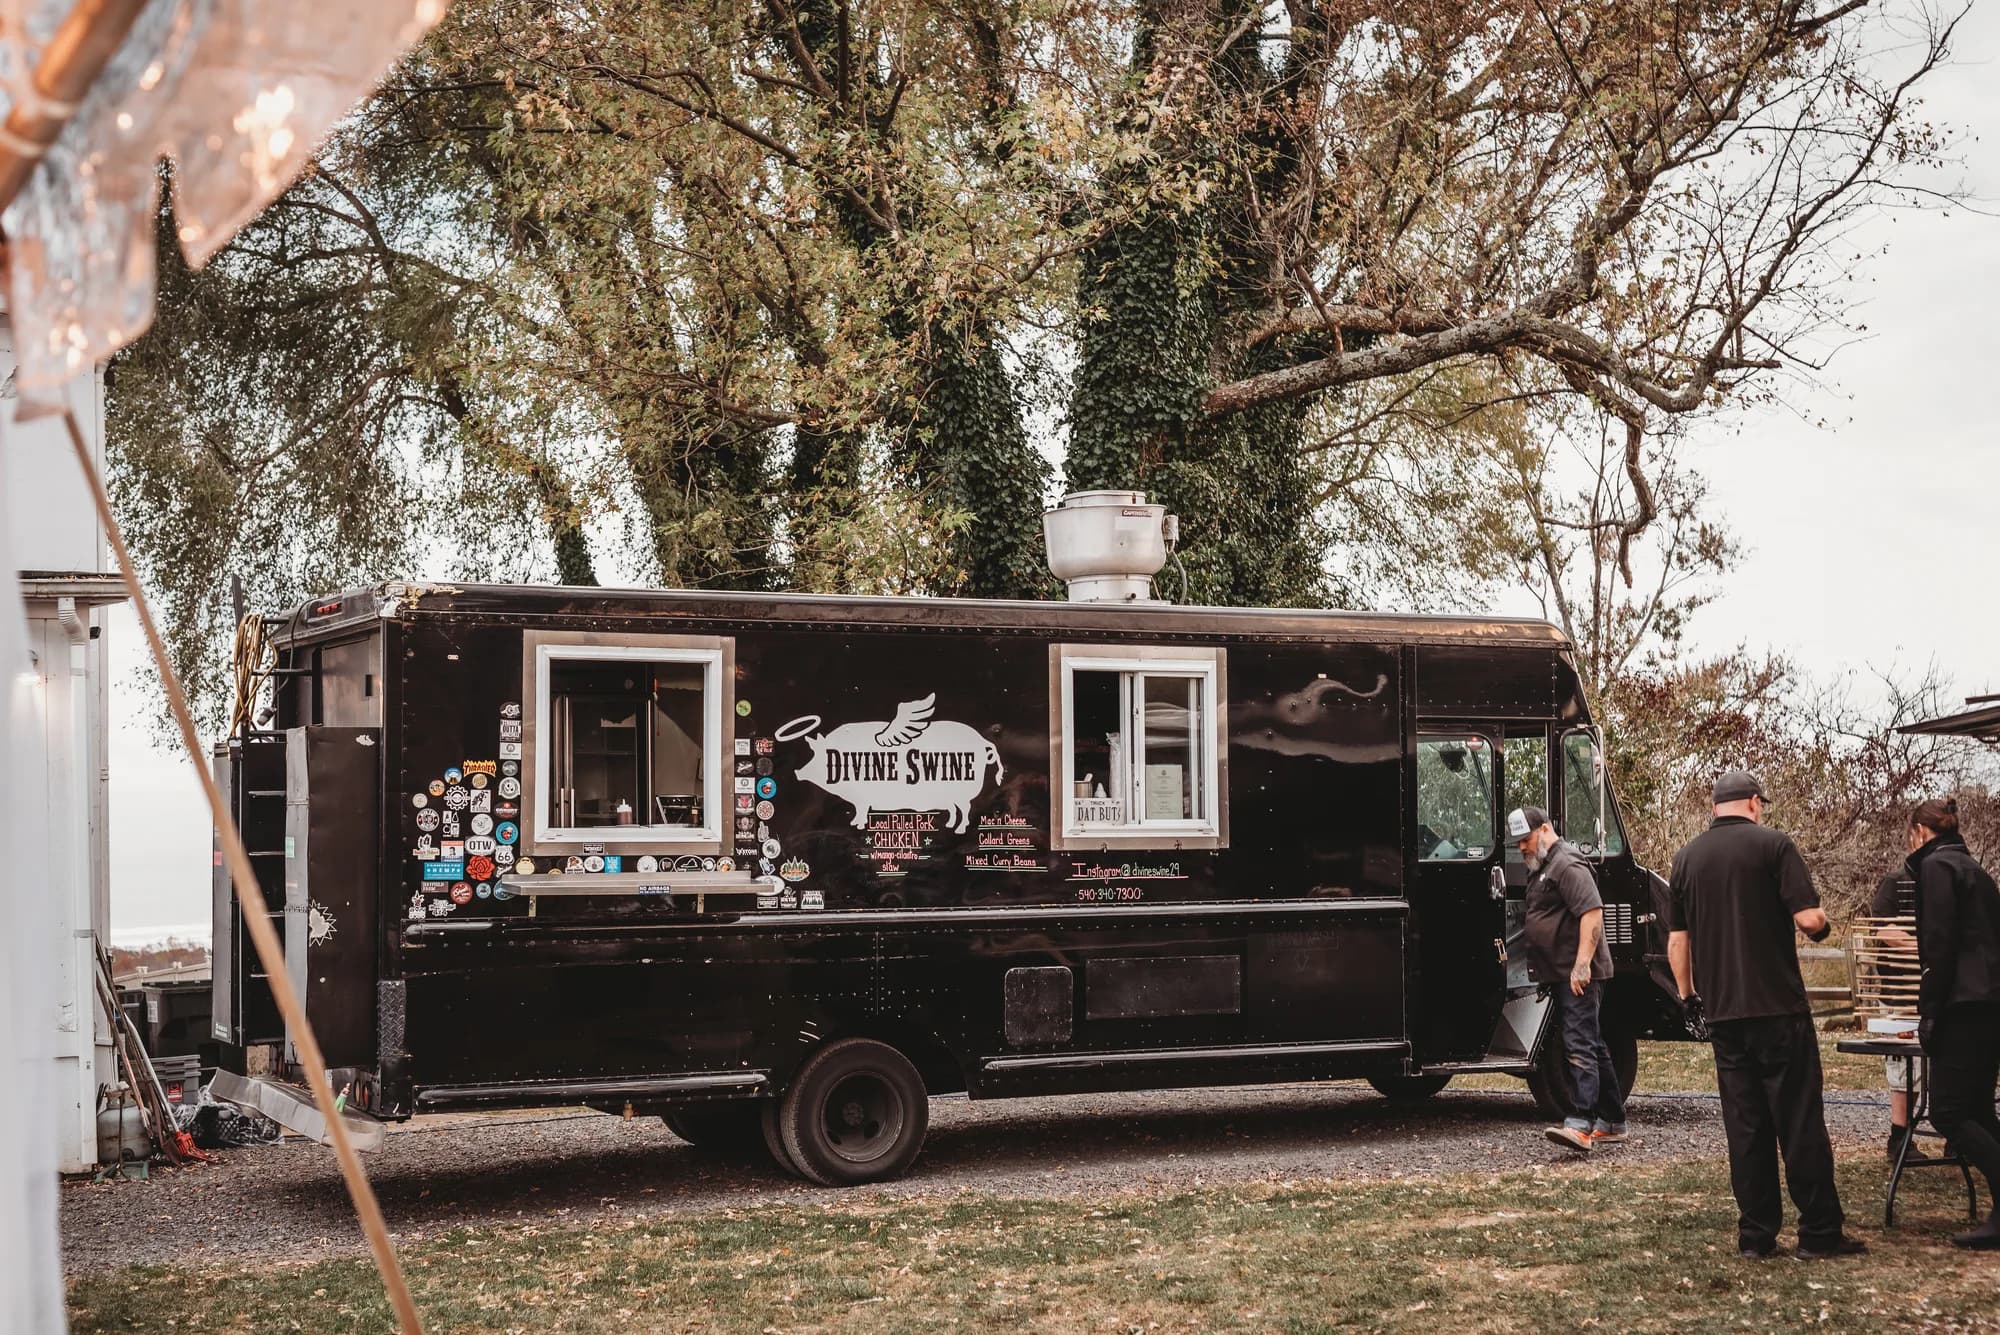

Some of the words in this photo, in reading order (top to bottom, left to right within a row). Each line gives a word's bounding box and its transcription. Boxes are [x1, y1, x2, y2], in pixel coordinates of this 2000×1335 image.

[826, 748, 898, 784] DIVINE
[906, 748, 975, 785] SWINE
[980, 815, 995, 825] Mac
[1004, 813, 1027, 825] Cheese
[1078, 807, 1096, 821] DAT
[869, 815, 890, 829] Local
[892, 814, 914, 830] Pulled
[469, 840, 492, 850] OTW
[874, 831, 919, 847] CHICKEN
[978, 832, 1003, 845] Collard
[1007, 832, 1030, 845] Greens
[497, 852, 510, 861] 66
[966, 854, 988, 865] Mixed
[993, 854, 1011, 872] Curry
[1013, 853, 1036, 866] Beans
[882, 861, 899, 871] slaw
